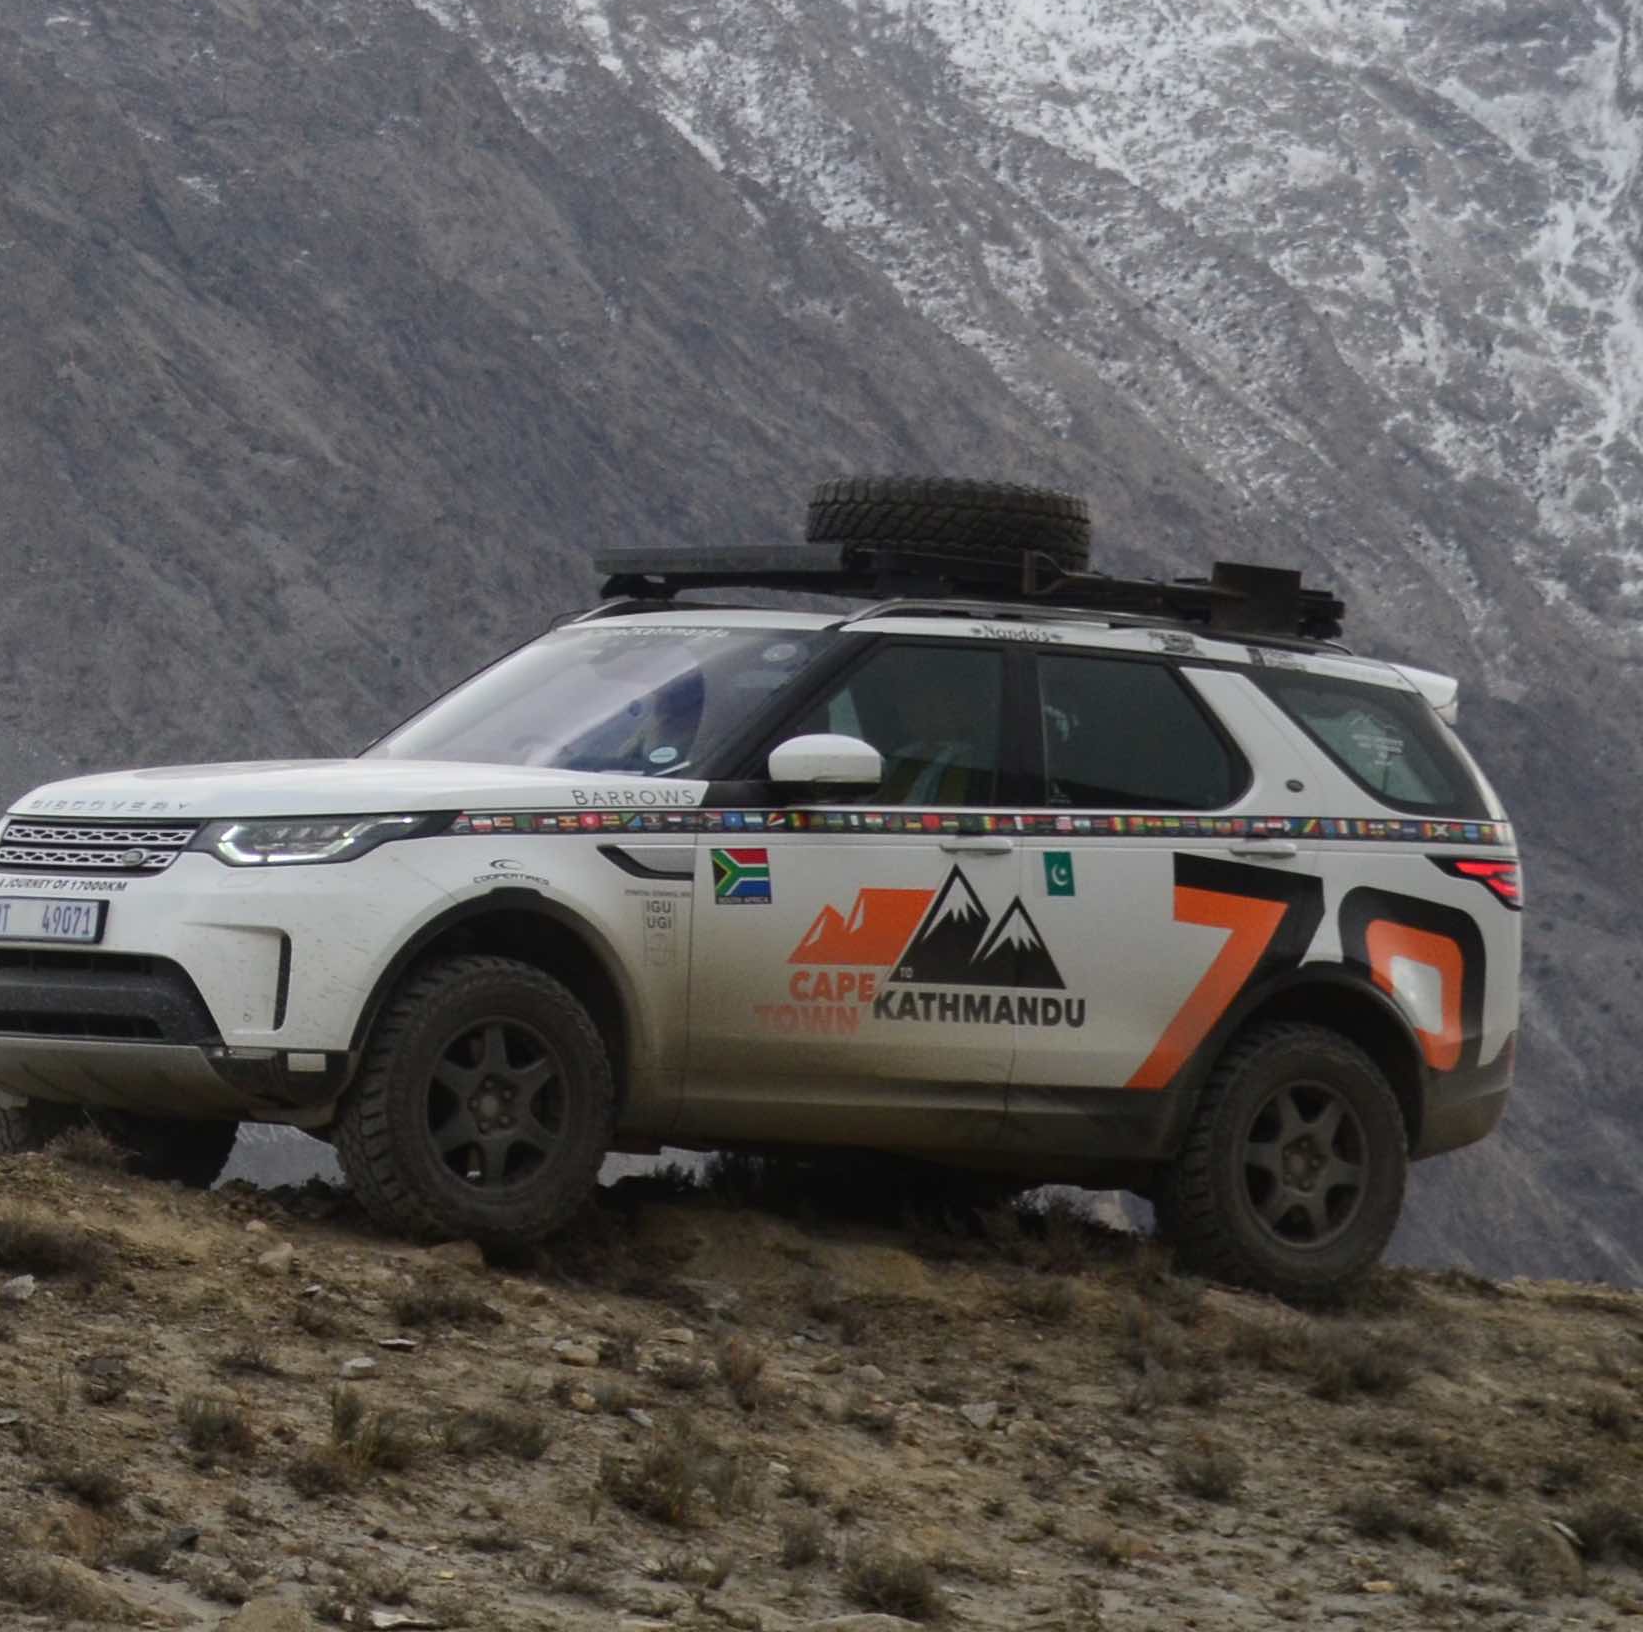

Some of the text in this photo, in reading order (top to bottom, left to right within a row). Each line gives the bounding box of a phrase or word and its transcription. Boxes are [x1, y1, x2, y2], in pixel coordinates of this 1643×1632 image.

[572, 789, 696, 806] BARROWS
[42, 904, 92, 935] 49071
[788, 971, 876, 1002] CAPE
[754, 1004, 860, 1034] TOWN
[873, 990, 1086, 1028] KATHMANDU
